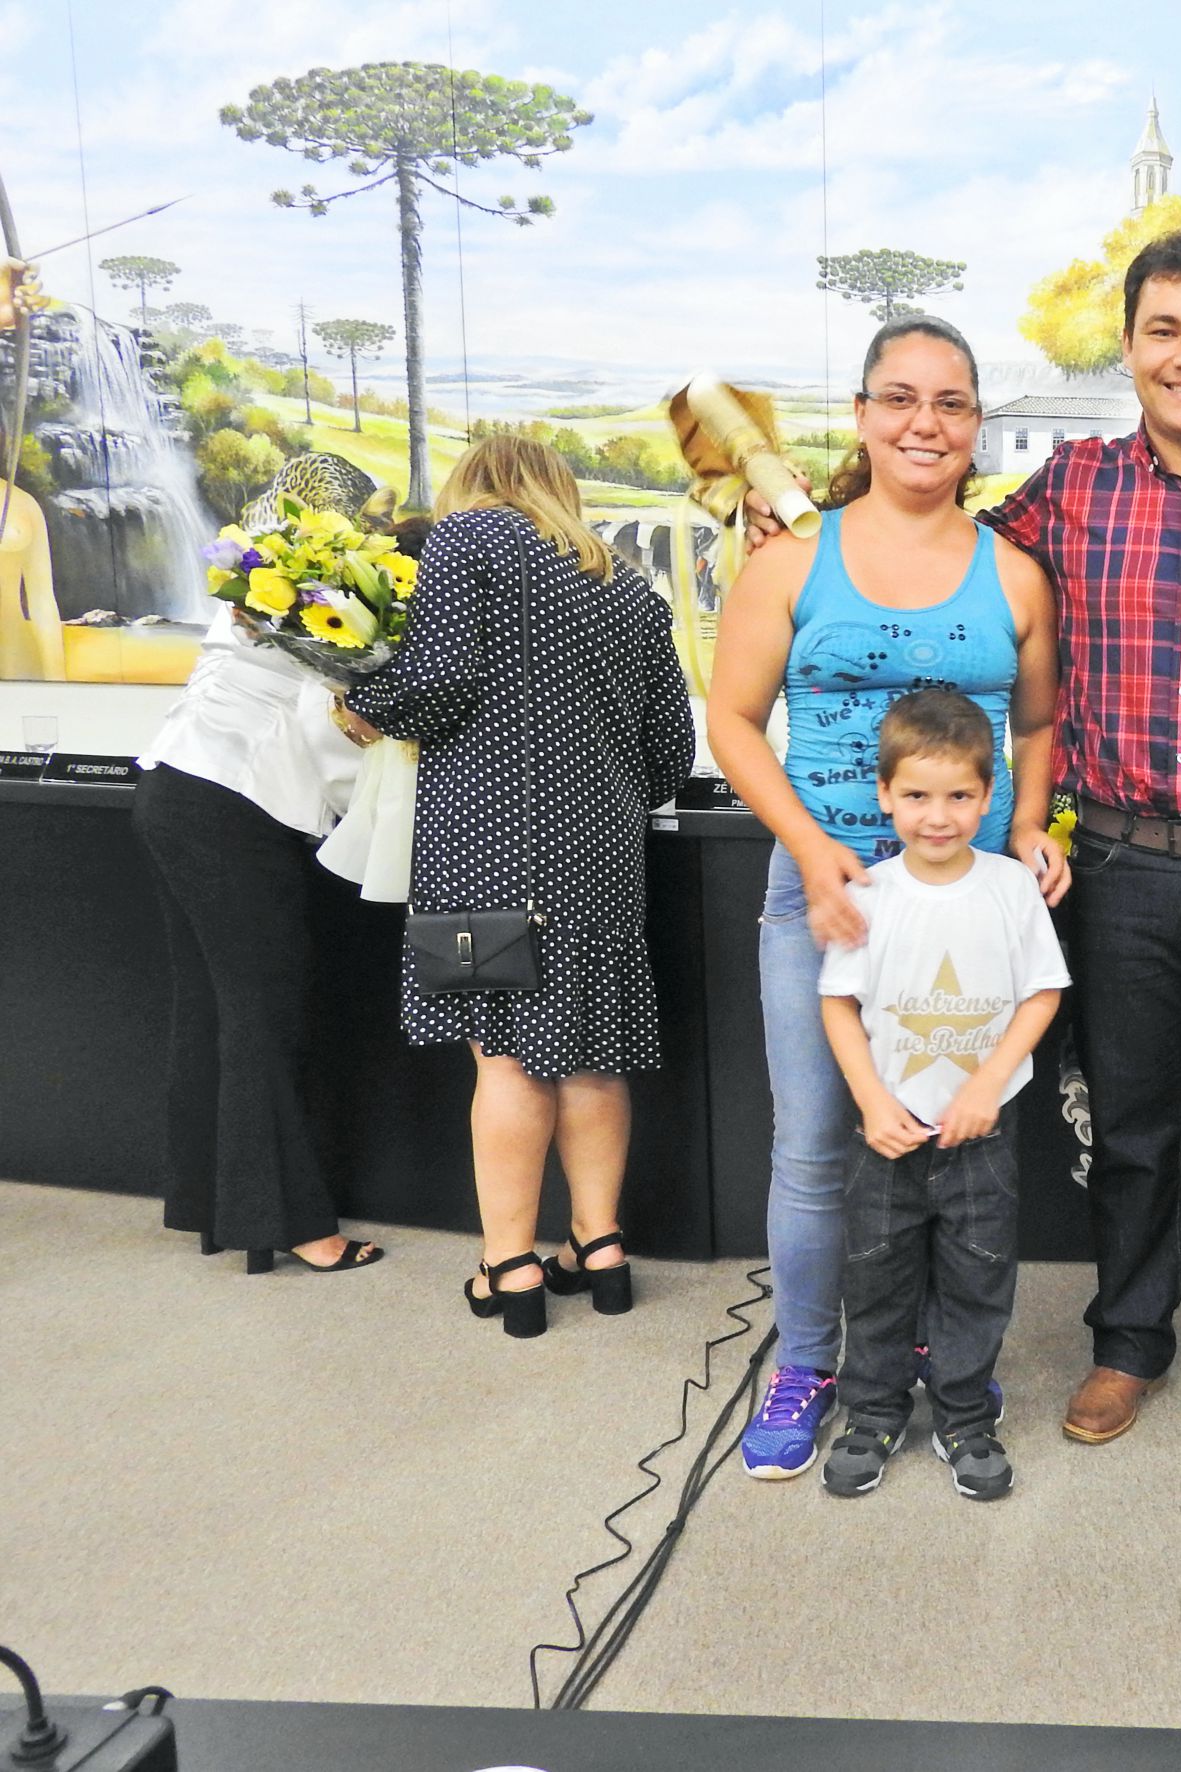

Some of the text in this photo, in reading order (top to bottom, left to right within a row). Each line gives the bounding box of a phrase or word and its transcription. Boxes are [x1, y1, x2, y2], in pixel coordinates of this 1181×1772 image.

[75, 764, 129, 776] SECRETÁRIO
[808, 764, 878, 787] Shar
[713, 781, 728, 793] ZÉ
[894, 1036, 923, 1053] ue
